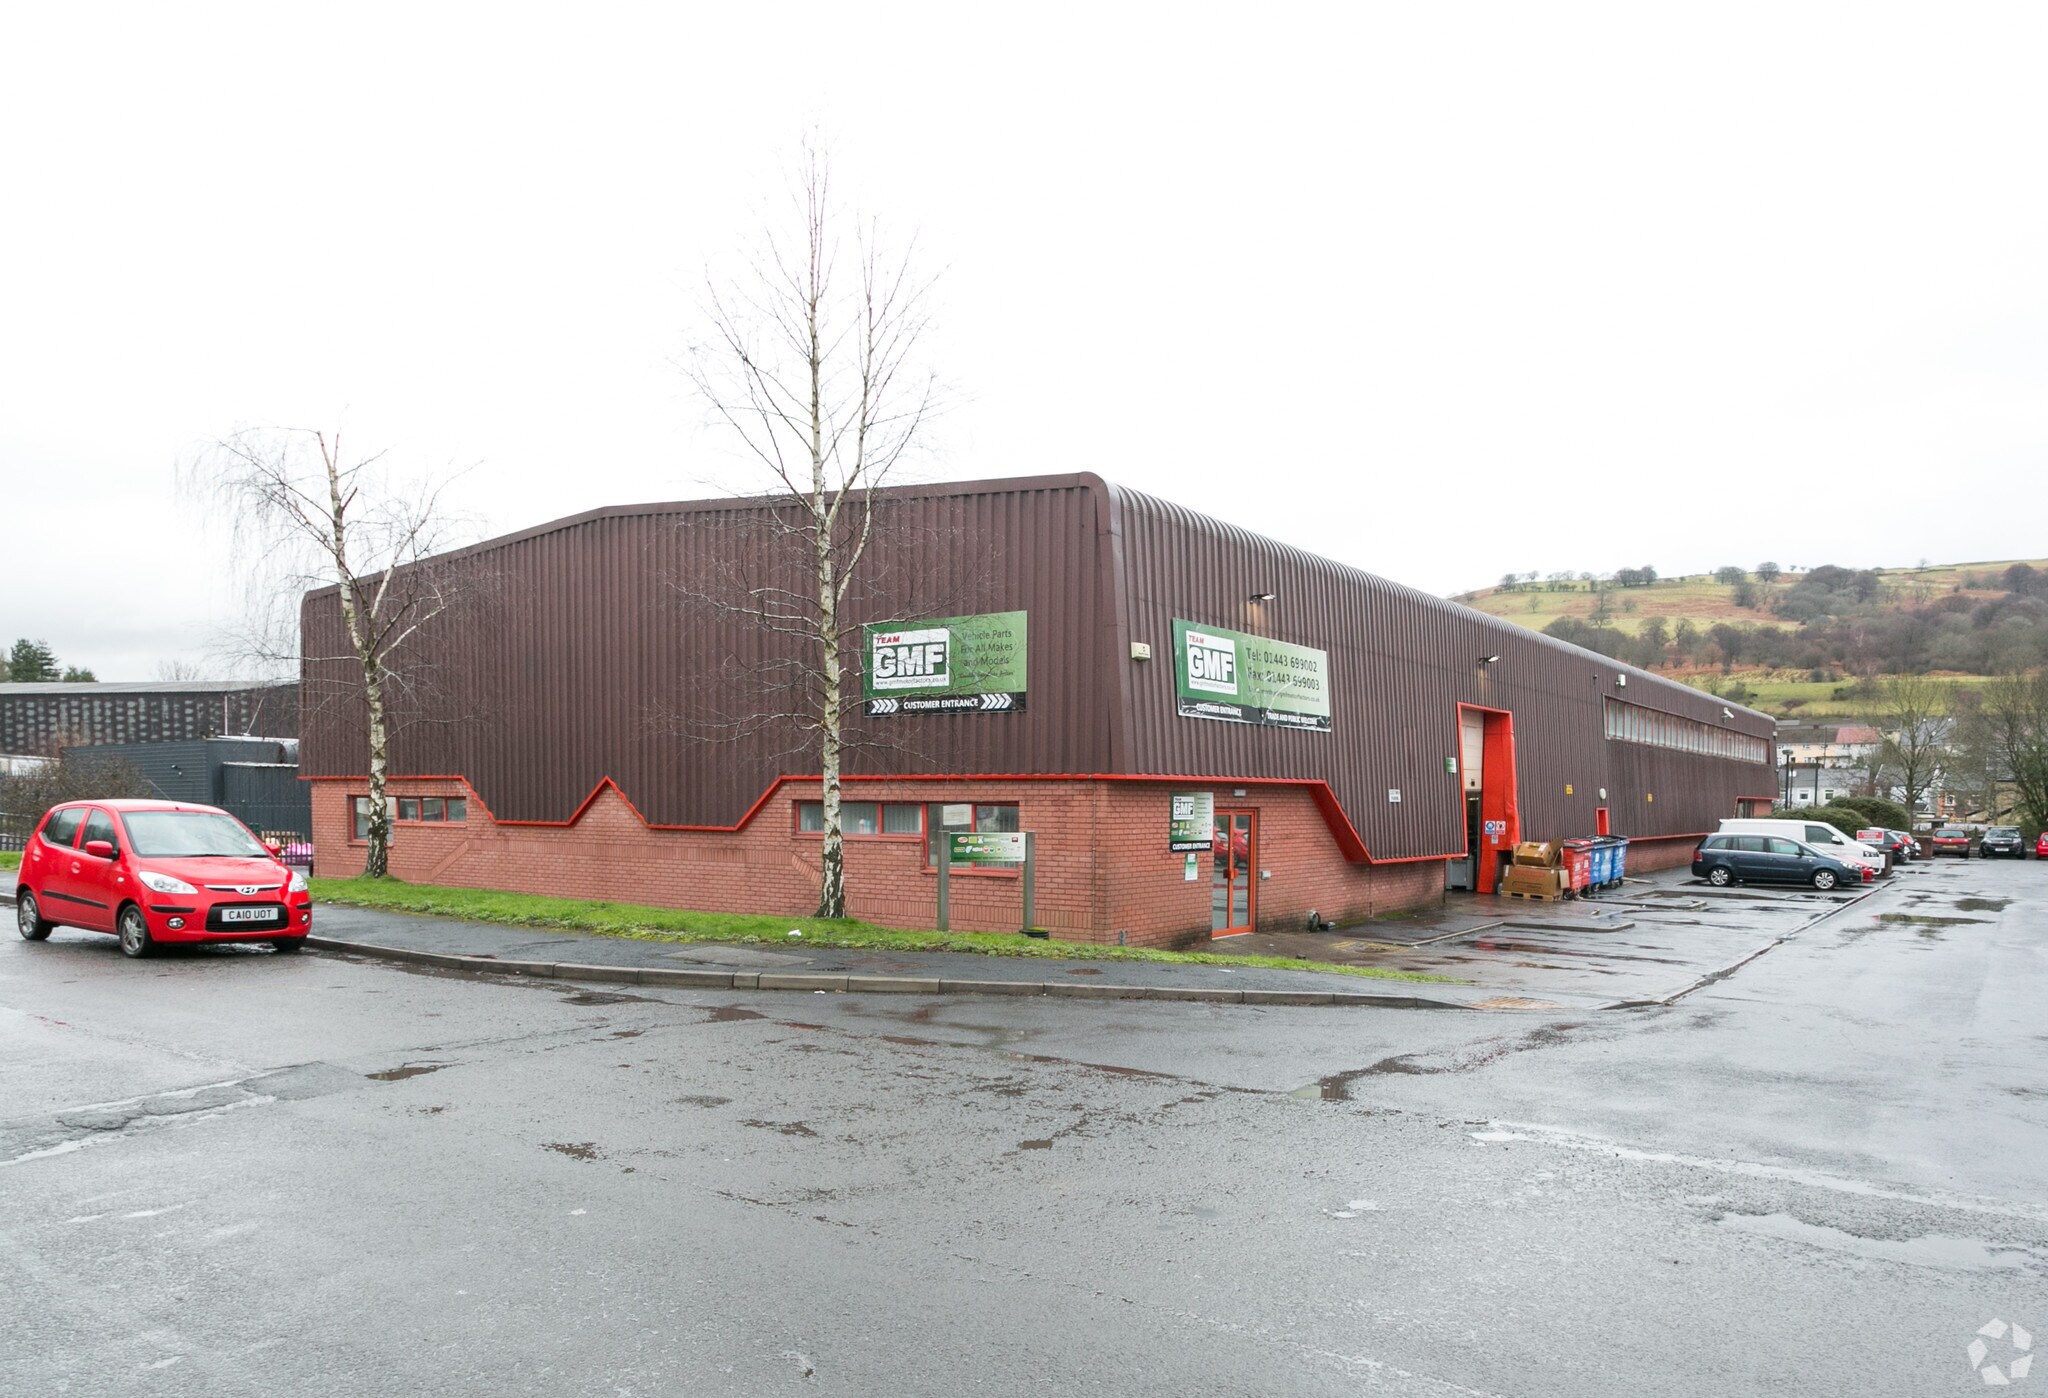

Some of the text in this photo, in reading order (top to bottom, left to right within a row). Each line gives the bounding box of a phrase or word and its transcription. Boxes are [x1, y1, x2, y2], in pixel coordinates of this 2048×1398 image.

[876, 636, 900, 644] TEAM
[962, 630, 1012, 641] Vehicle Parts
[1188, 635, 1204, 644] TEAM
[961, 643, 1013, 654] For All Makes
[876, 644, 945, 678] GMF
[980, 656, 1010, 666] Models
[1188, 646, 1233, 682] GMF
[1246, 647, 1317, 673] Tel: 01443 699002
[1247, 667, 1320, 691] Fax: 01443 699003
[903, 698, 978, 710] CUSTOMER ENTRANCE
[1197, 703, 1242, 716] CUSTOMER ENTRANCE
[1174, 802, 1194, 815] GMF
[1192, 842, 1211, 850] ENTRANCE
[229, 909, 272, 920] CA10 UOT
